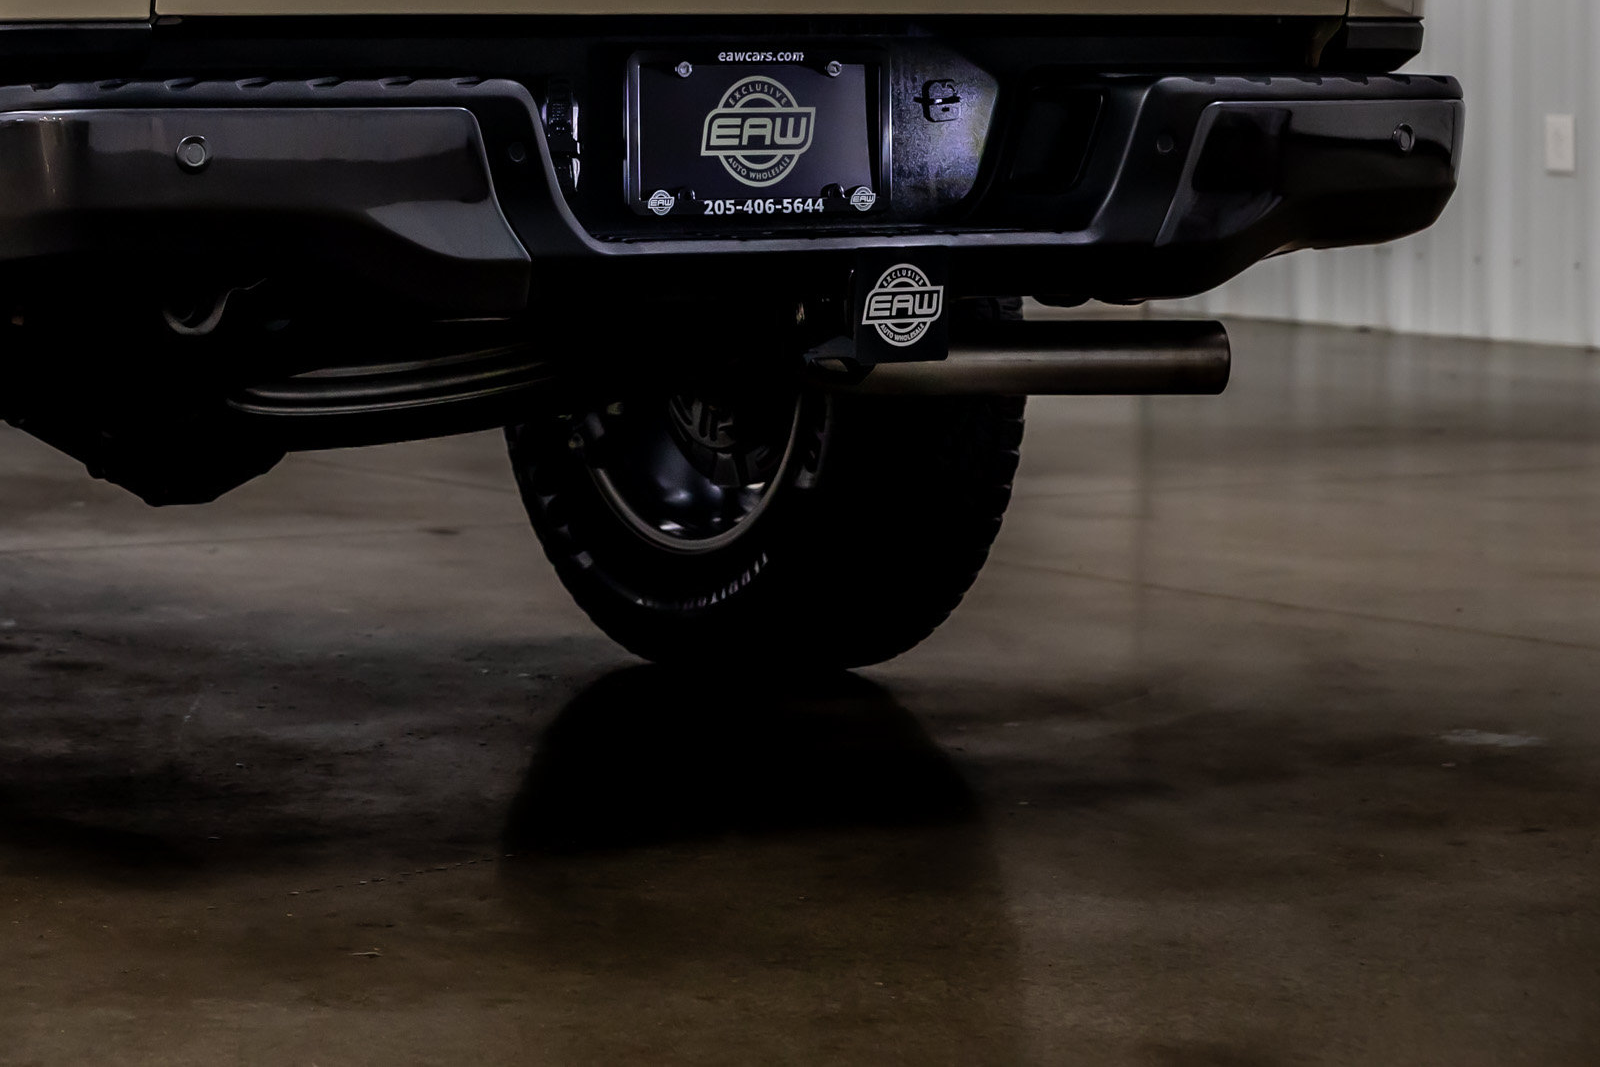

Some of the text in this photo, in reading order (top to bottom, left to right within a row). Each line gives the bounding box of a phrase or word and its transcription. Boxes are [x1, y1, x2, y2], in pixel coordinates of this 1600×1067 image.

[717, 50, 805, 63] eawcars.com
[728, 82, 788, 105] EXCLUSIVE
[709, 116, 808, 146] EAW
[728, 156, 791, 181] AUTO WHOLESALE
[703, 197, 825, 215] 205-406-5644
[882, 269, 925, 287] EXCLUSIVE
[869, 293, 939, 318] EAW
[880, 323, 893, 339] AUTO
